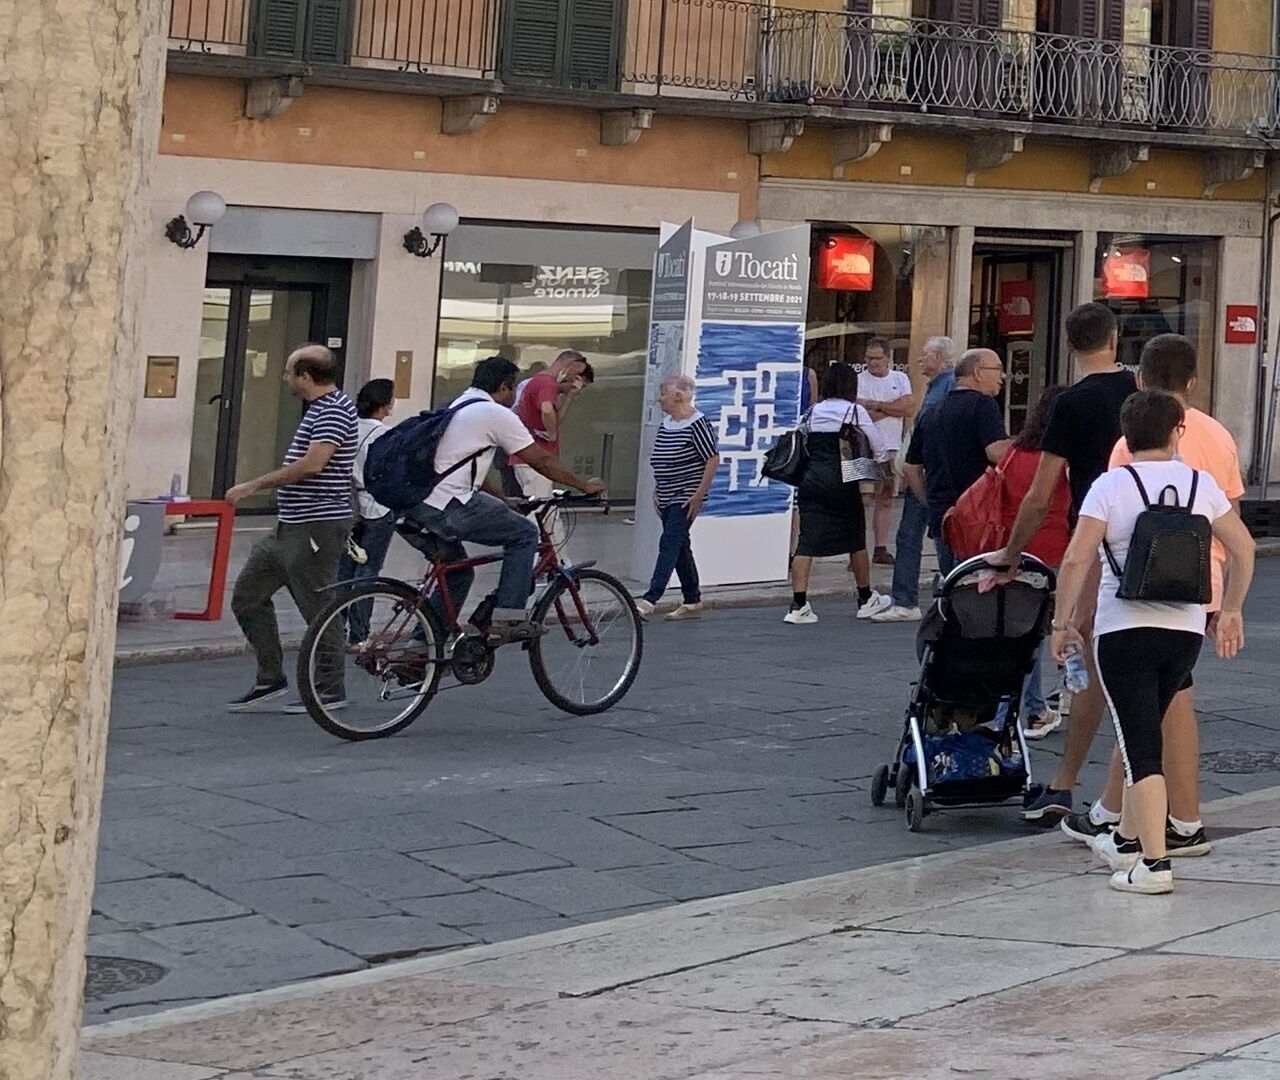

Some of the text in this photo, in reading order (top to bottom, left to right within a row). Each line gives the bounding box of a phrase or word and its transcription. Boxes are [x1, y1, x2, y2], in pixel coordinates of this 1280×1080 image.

[735, 252, 798, 281] Tocatì
[707, 292, 803, 304] 17-18-19 SETTEMBRE 2021
